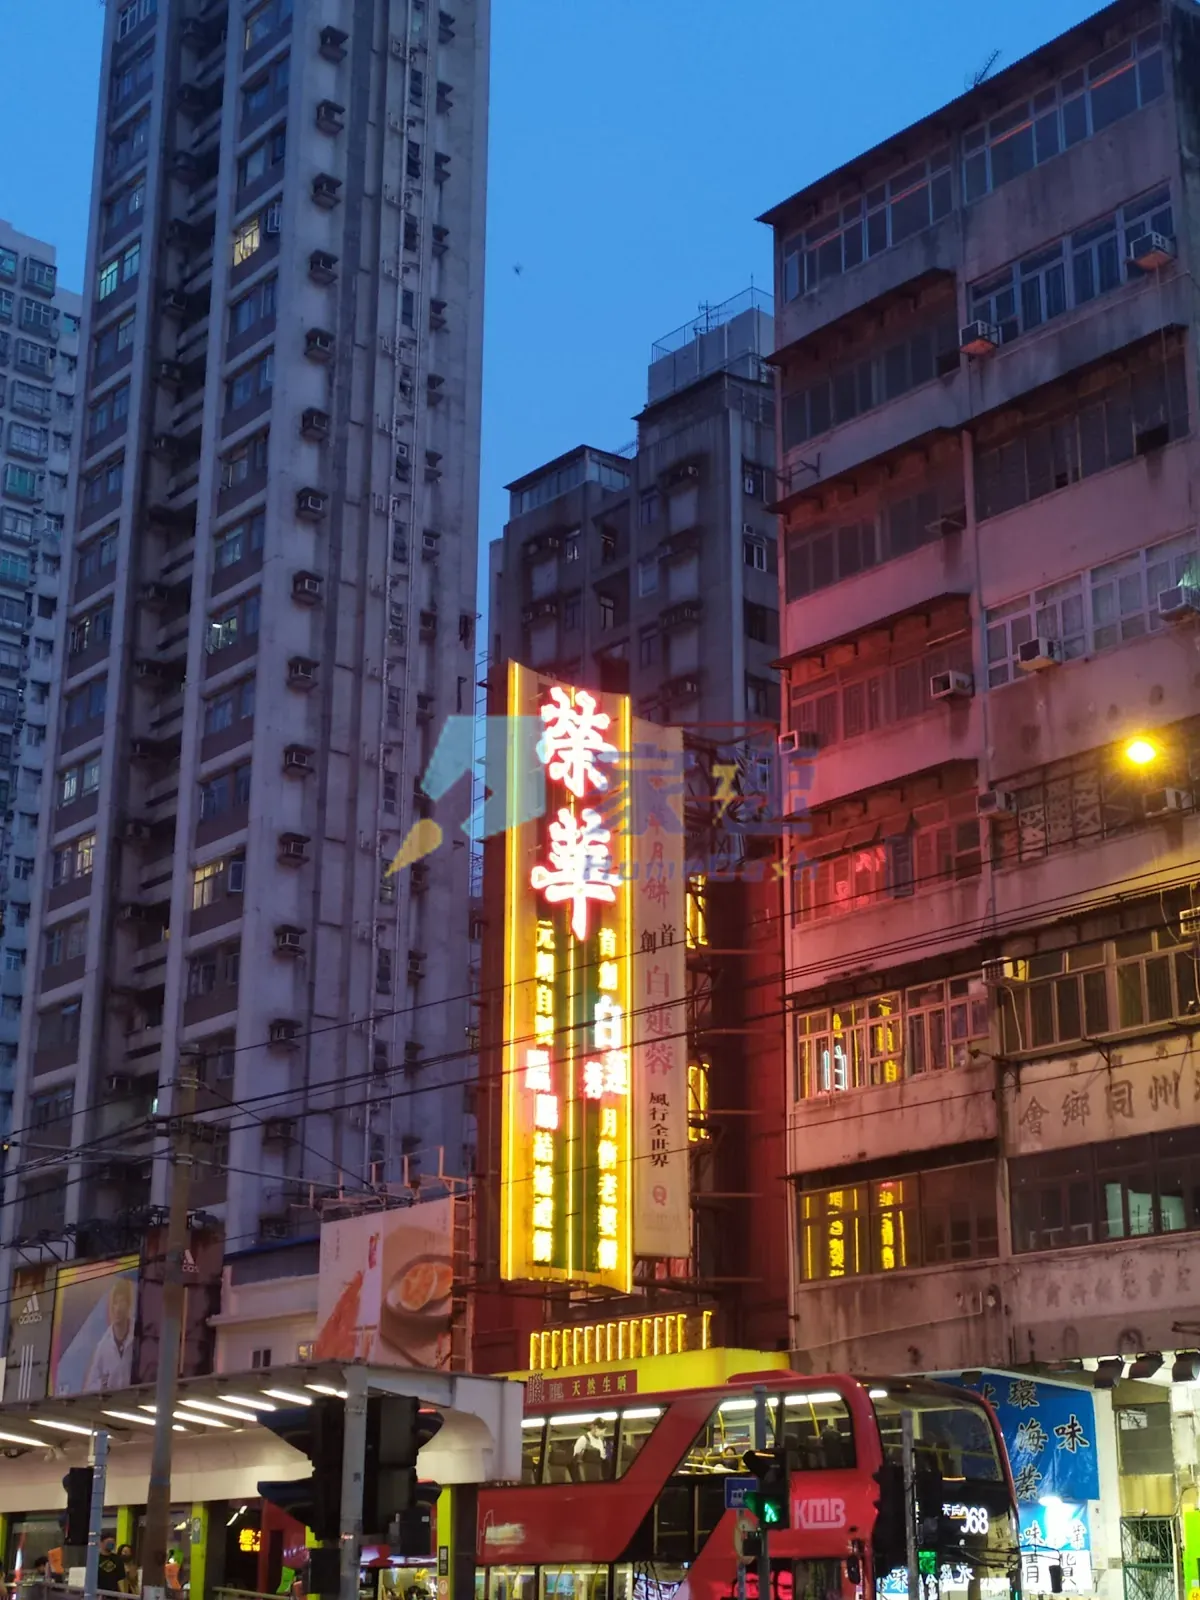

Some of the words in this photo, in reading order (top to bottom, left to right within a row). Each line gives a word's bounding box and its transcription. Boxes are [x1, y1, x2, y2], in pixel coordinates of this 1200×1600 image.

[531, 686, 619, 941] 榮華
[640, 923, 676, 954] 首創
[644, 965, 674, 1076] 白蓮蓉
[649, 1091, 670, 1168] 風行全世界
[1016, 1414, 1090, 1456] 海味
[794, 1498, 847, 1530] KMB
[941, 1503, 961, 1516] 天后
[959, 1506, 989, 1534] 968
